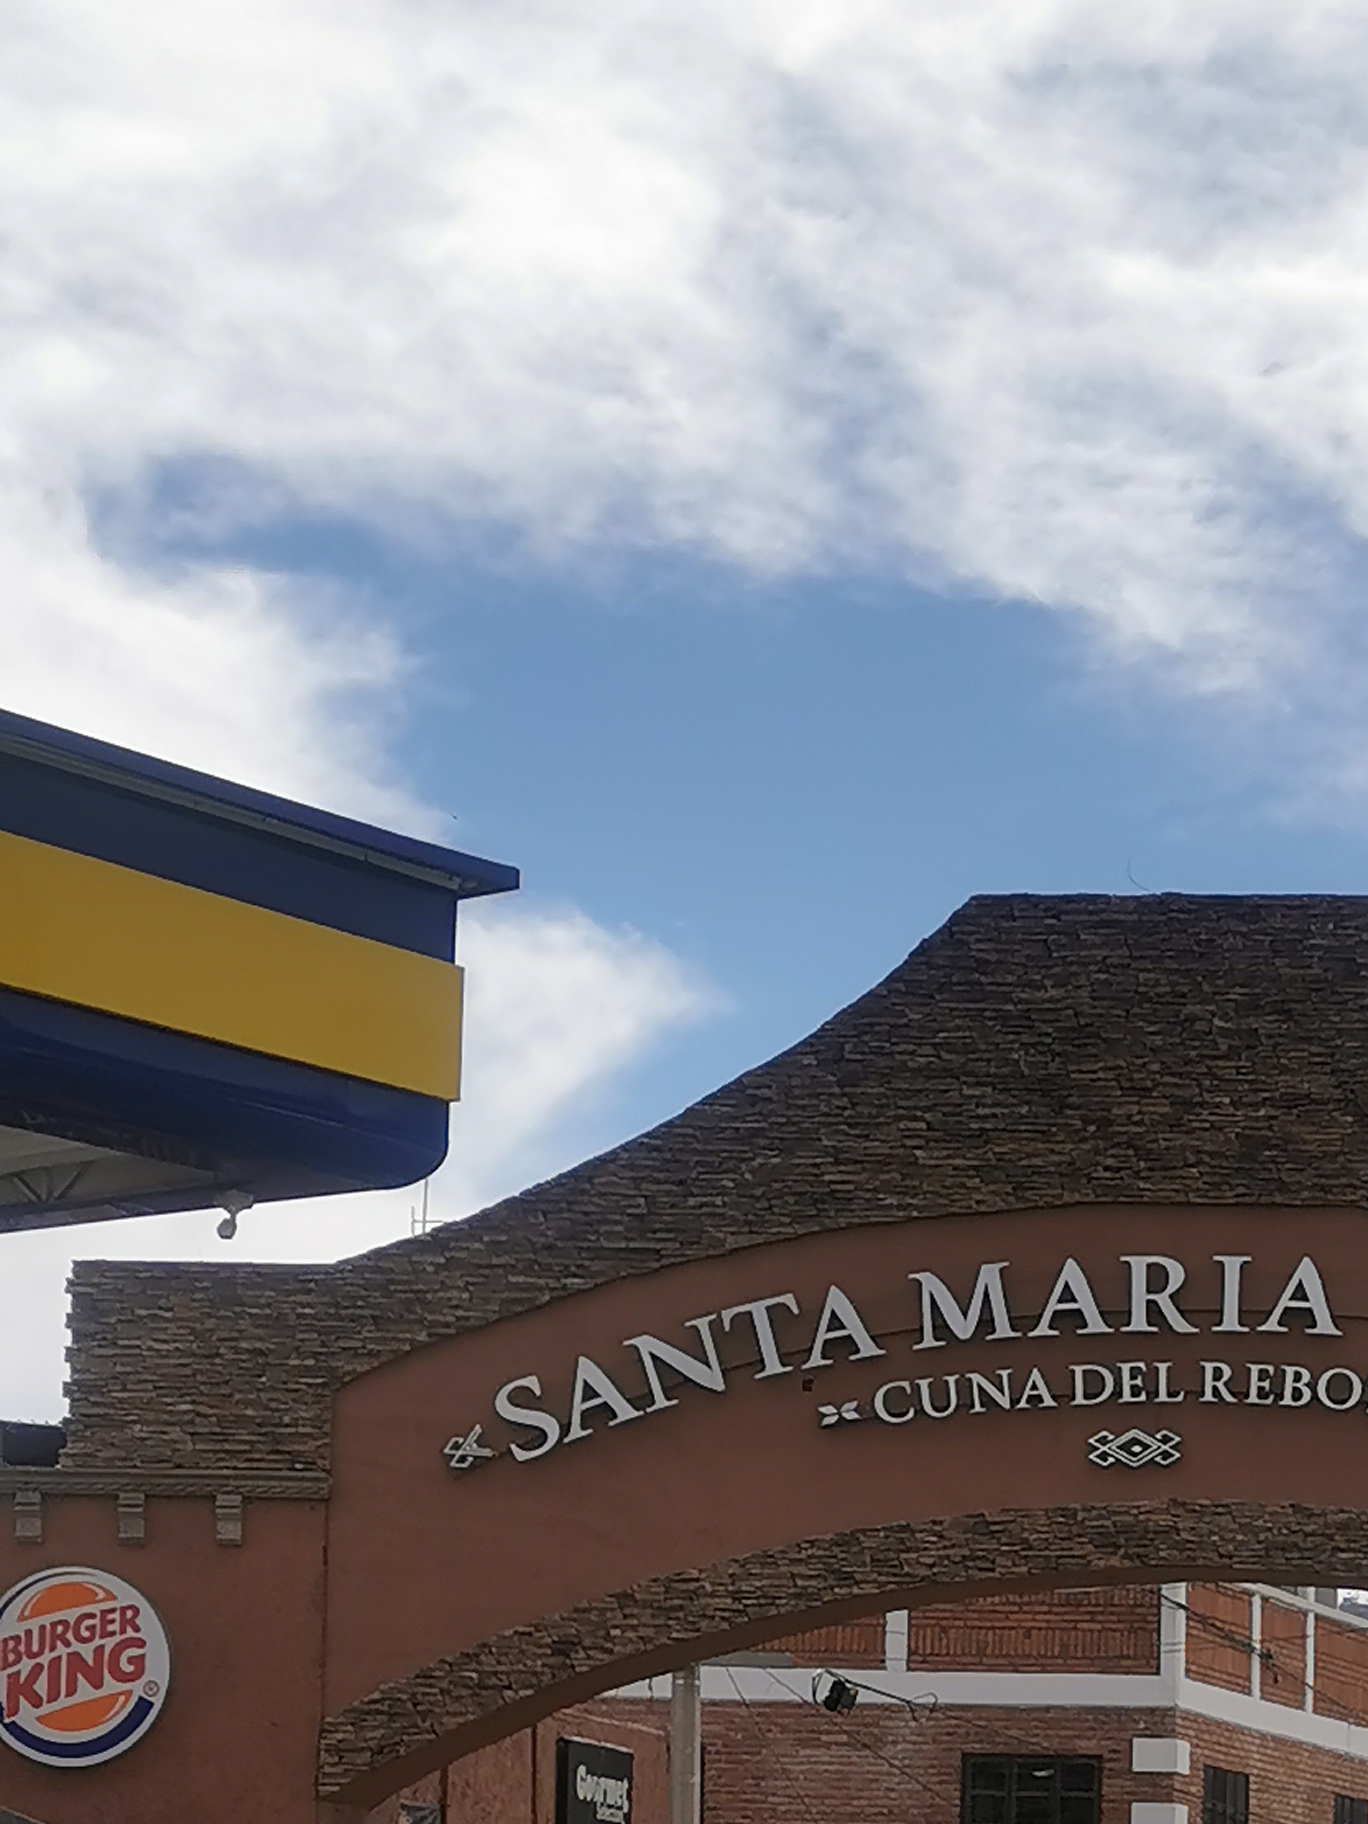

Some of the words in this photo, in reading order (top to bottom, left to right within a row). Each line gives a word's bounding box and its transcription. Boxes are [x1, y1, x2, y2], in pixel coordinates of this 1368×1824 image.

[494, 1285, 887, 1463] SANTA
[908, 1255, 1343, 1350] MARIA
[874, 1367, 1058, 1425] CUNA
[1068, 1360, 1185, 1407] DEL
[0, 1604, 141, 1672] BURGER
[5, 1636, 147, 1720] KING
